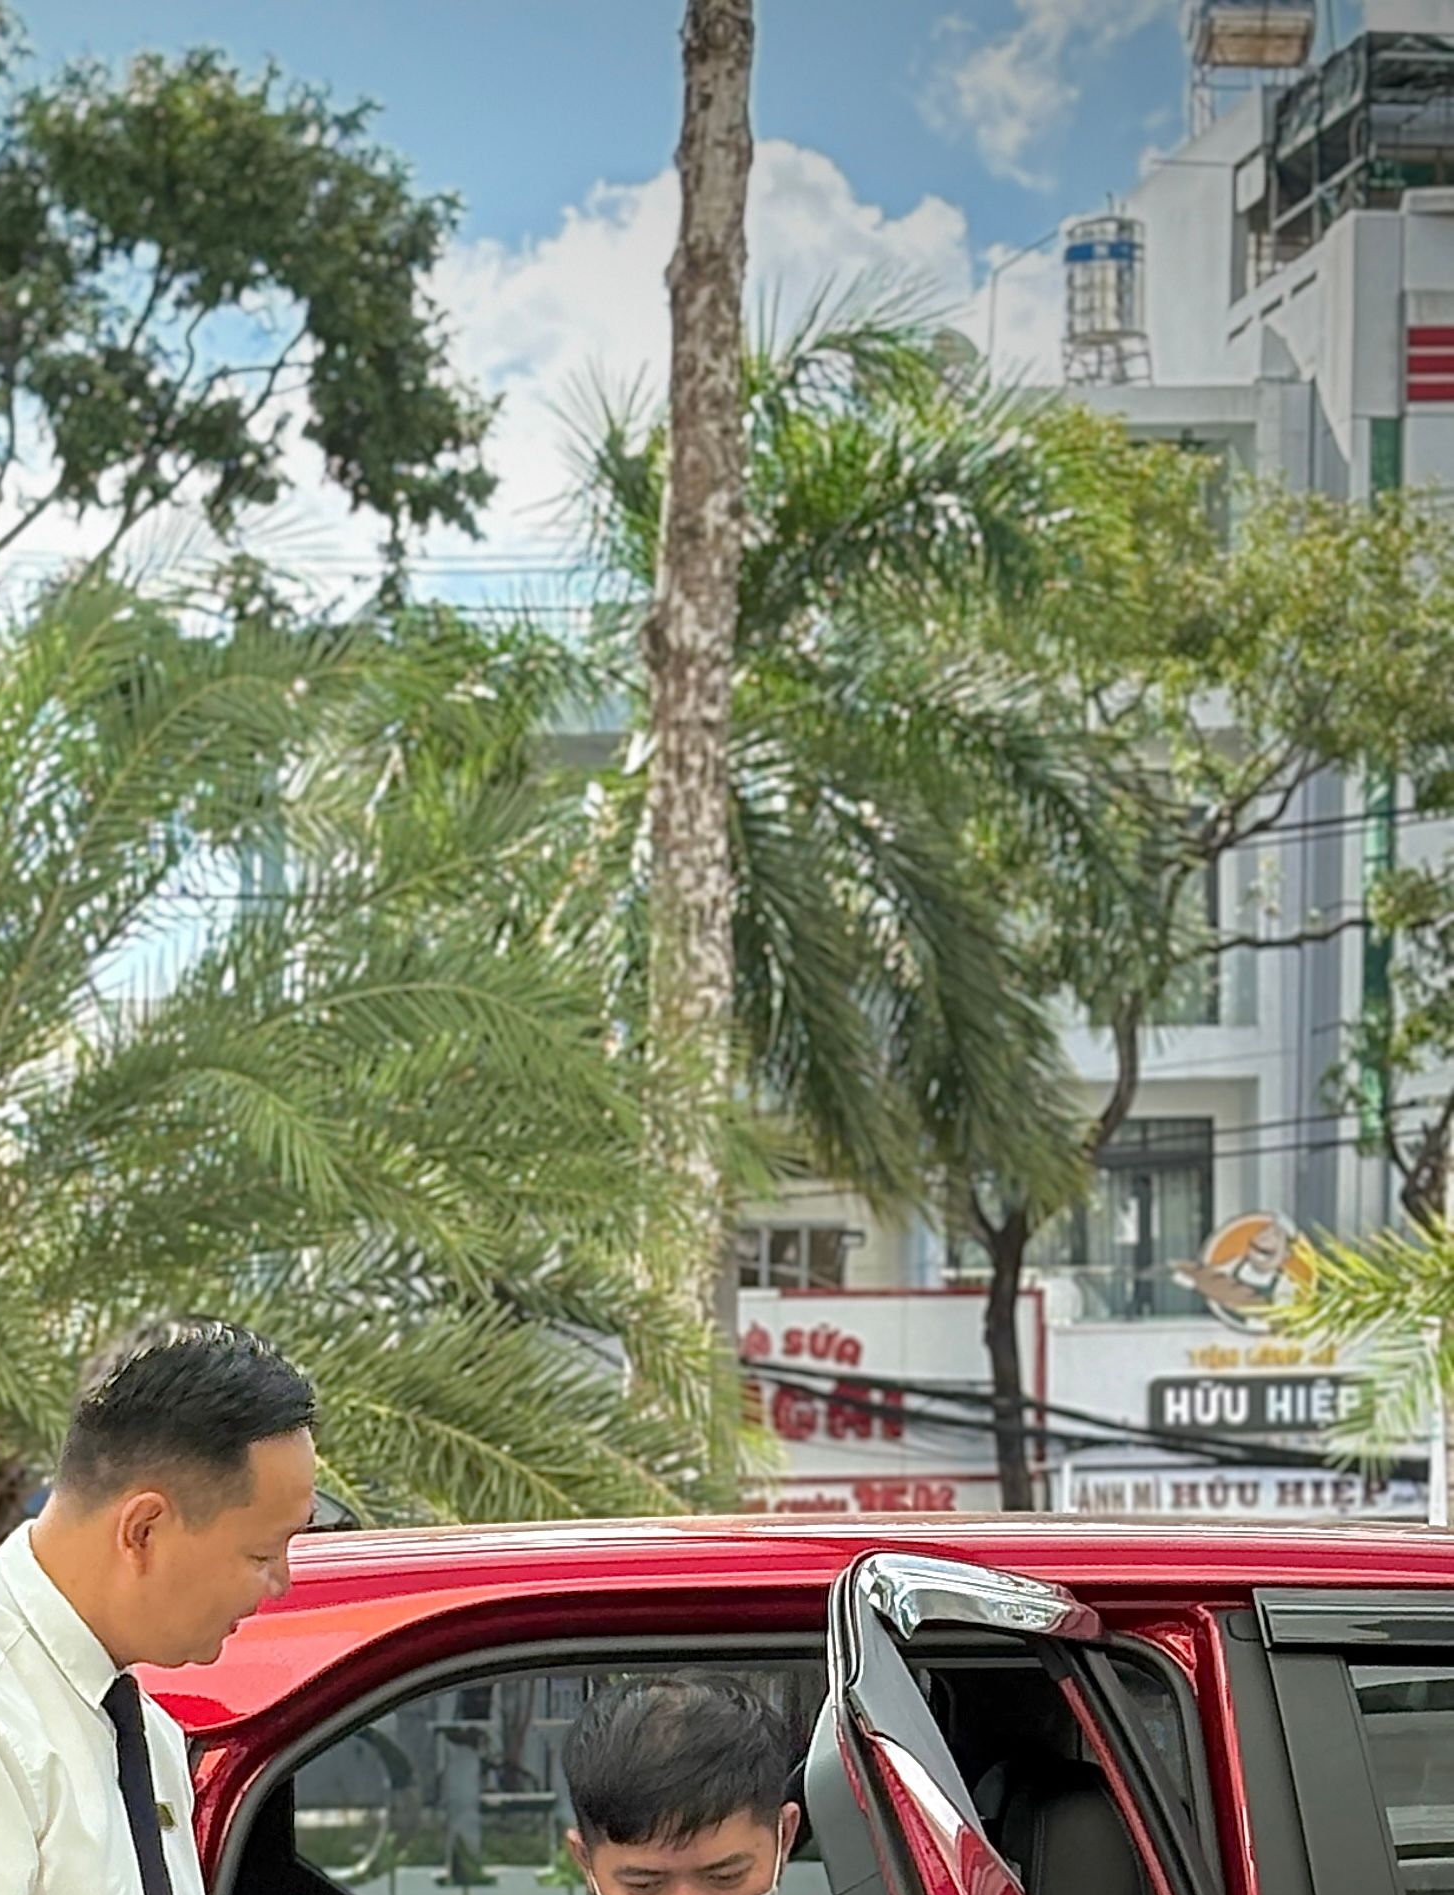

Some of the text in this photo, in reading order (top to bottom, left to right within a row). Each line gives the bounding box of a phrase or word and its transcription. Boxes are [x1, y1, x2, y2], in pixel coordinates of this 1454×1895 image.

[782, 1322, 862, 1366] SỮA
[1164, 1377, 1362, 1430] HỮU HIỆP
